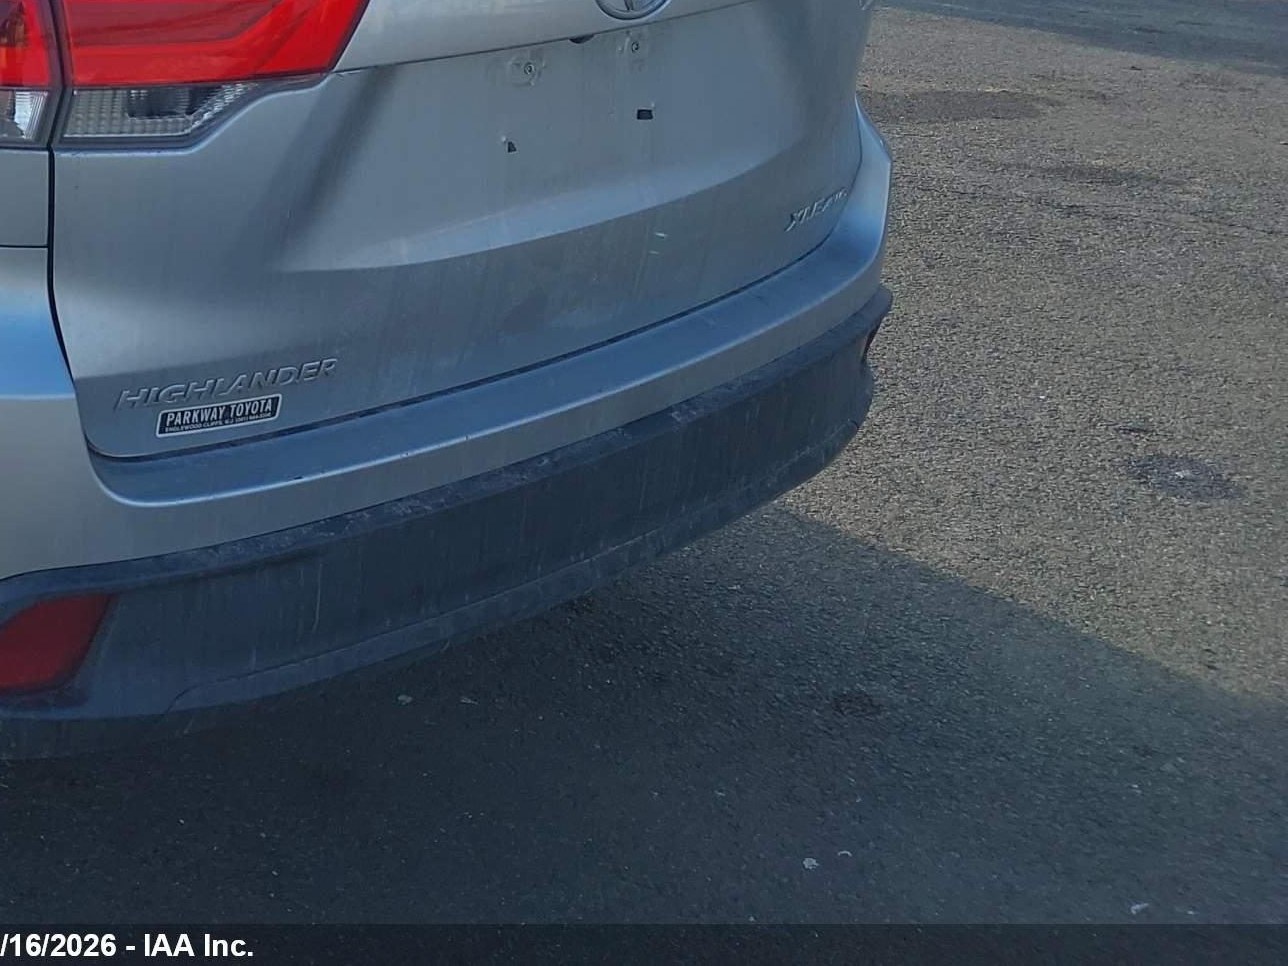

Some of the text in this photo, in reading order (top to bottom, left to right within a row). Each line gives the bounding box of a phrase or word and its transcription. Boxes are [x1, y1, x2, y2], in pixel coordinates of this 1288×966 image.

[114, 358, 338, 410] HIGHLANDER
[166, 398, 272, 427] PARKWAY TOYOTA
